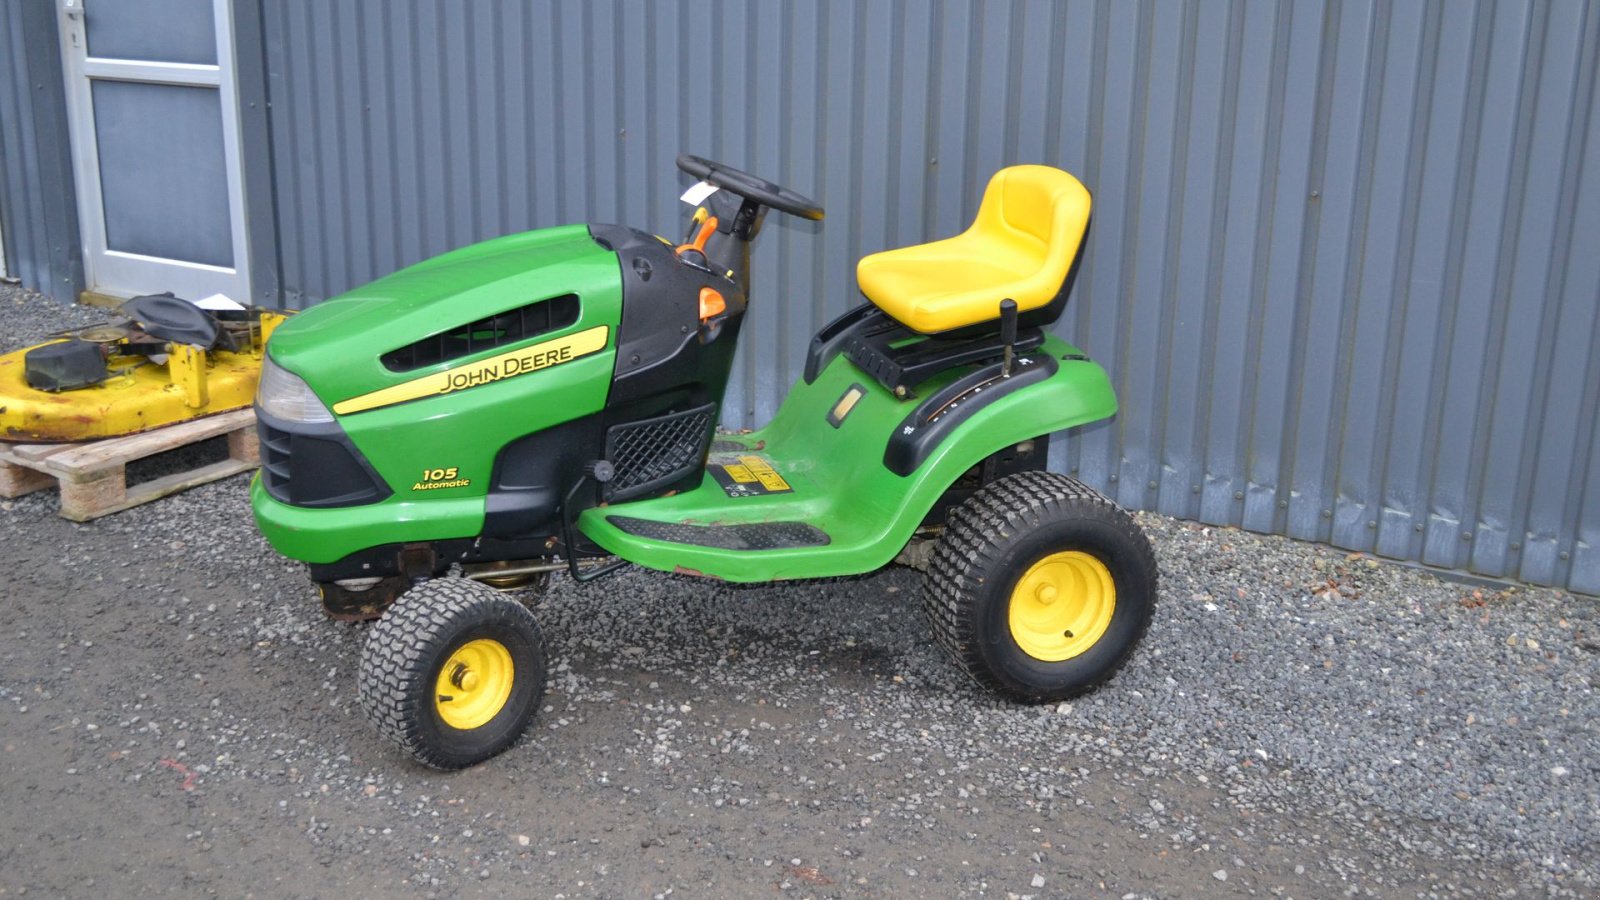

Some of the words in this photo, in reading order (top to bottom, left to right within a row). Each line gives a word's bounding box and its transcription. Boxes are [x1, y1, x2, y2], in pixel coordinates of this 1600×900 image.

[440, 365, 498, 392] JOHN
[504, 346, 571, 375] DEERE
[422, 467, 459, 481] 105
[412, 478, 470, 491] Automatic
